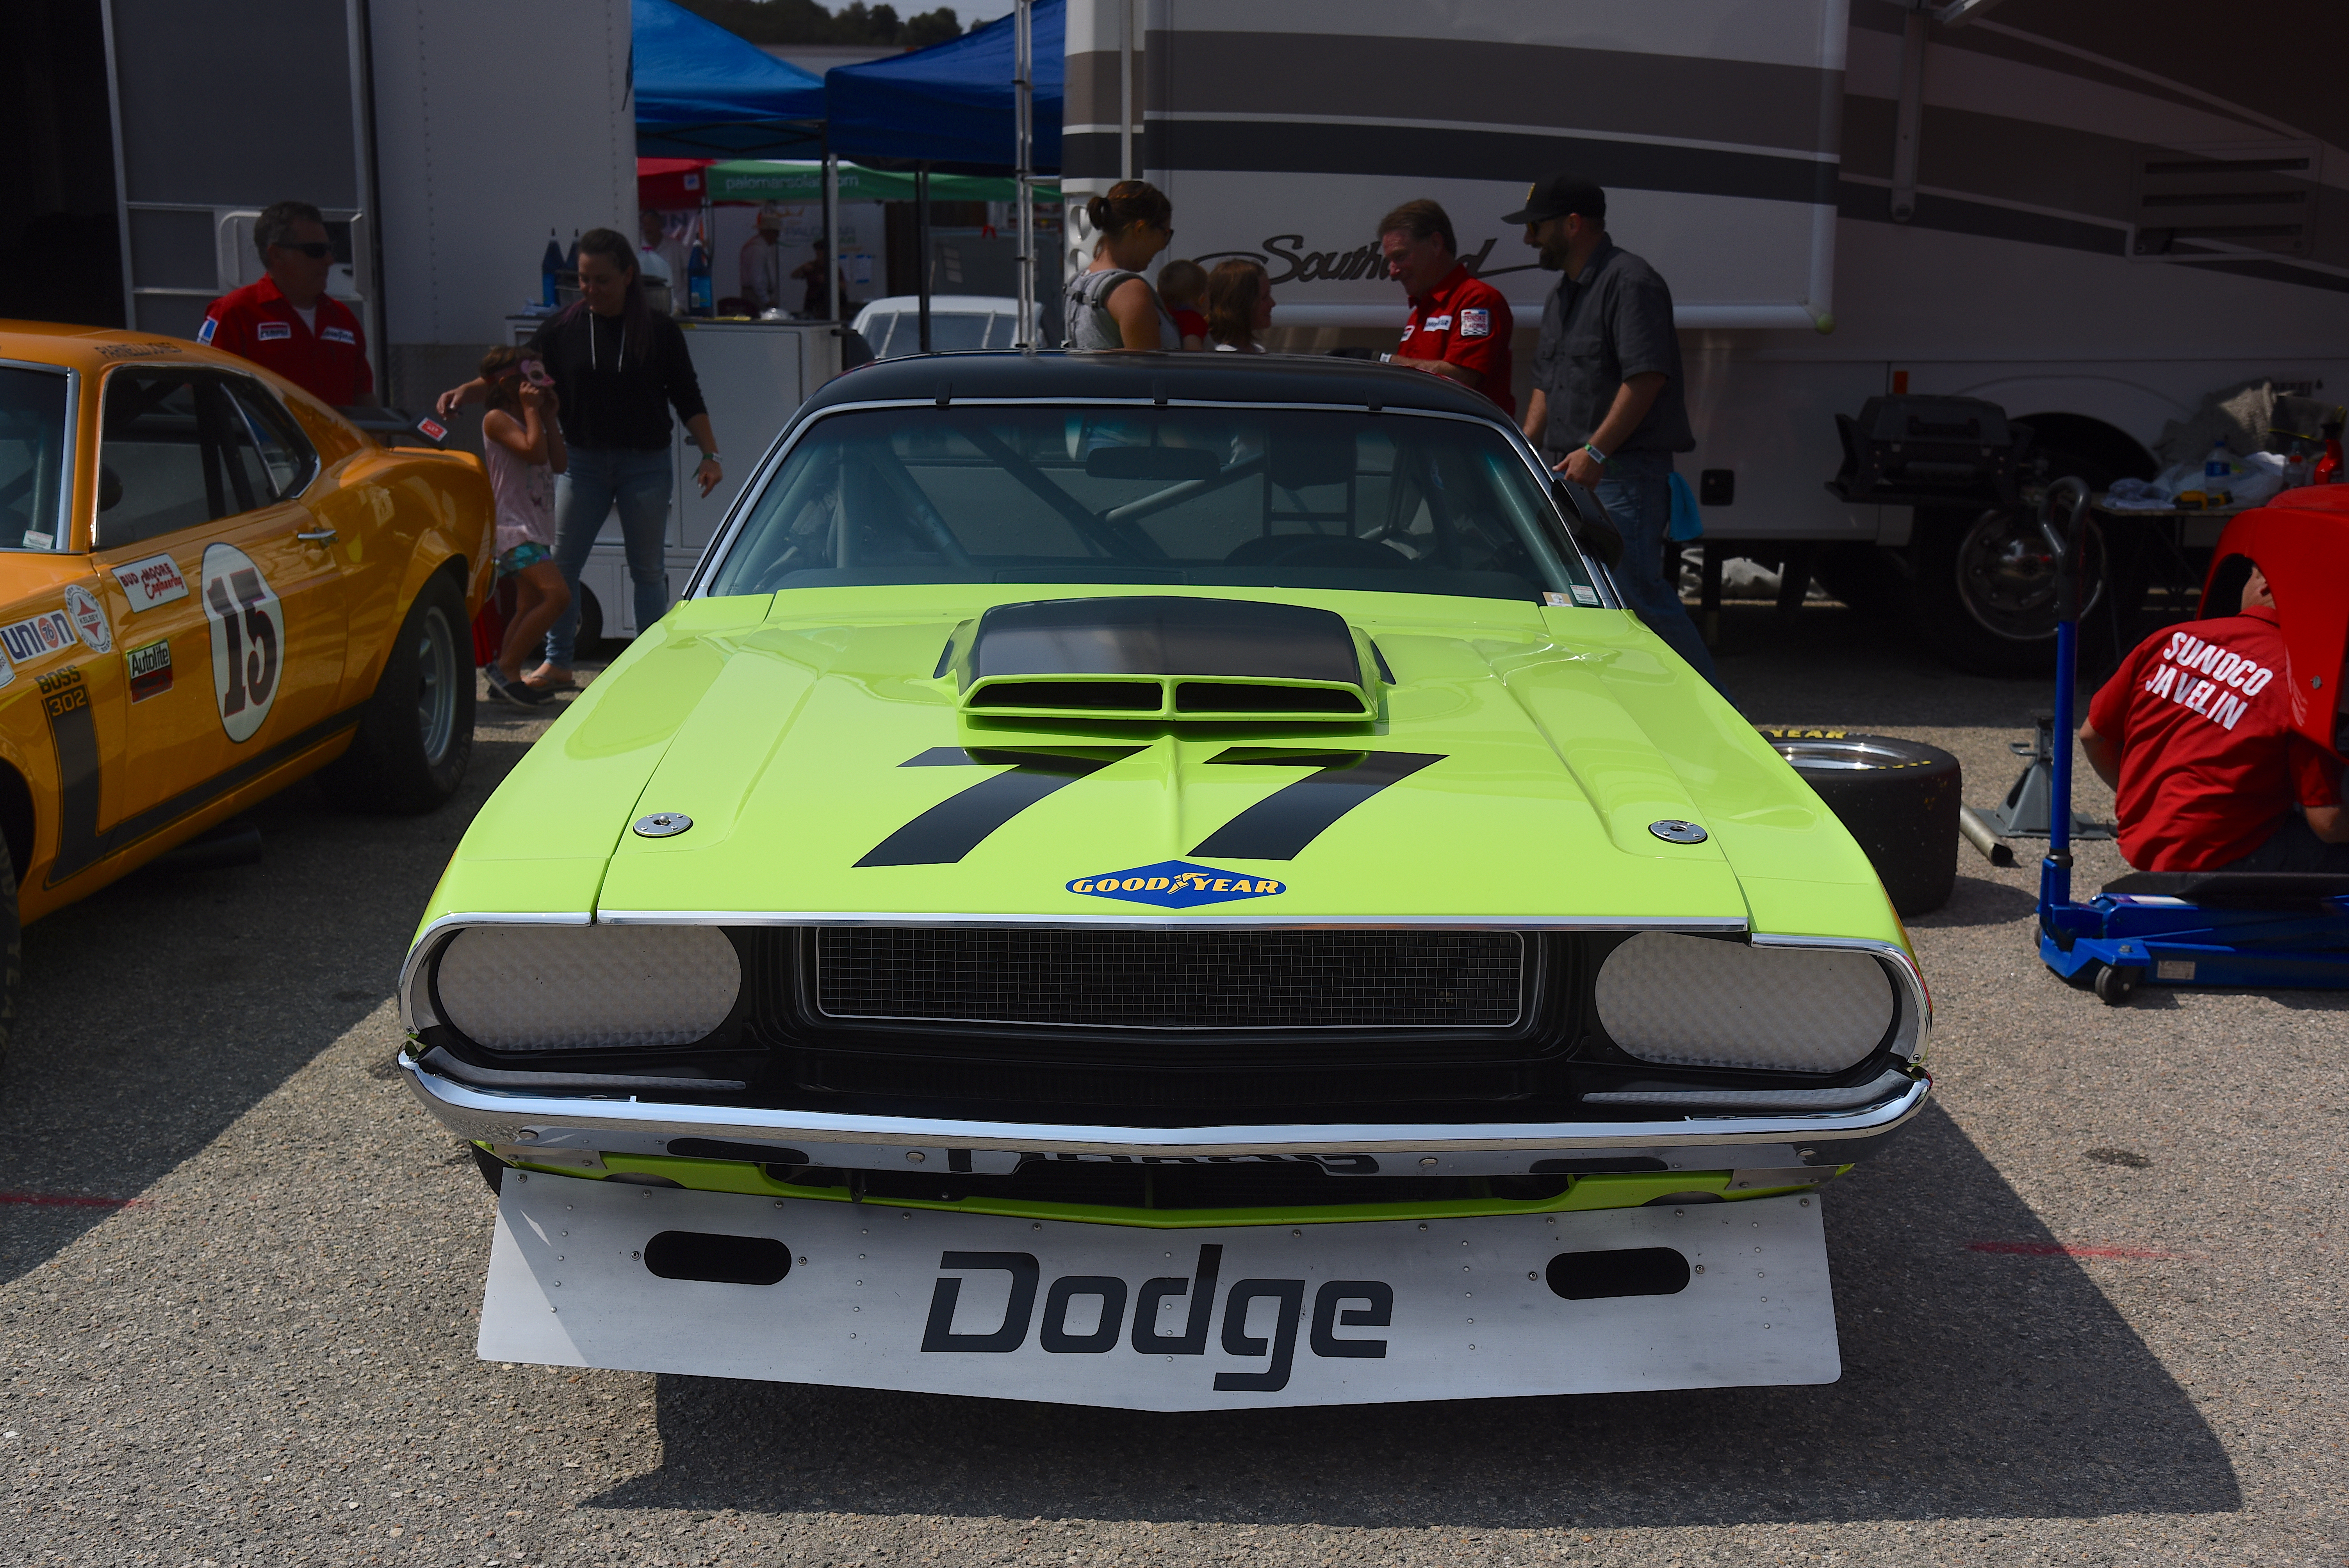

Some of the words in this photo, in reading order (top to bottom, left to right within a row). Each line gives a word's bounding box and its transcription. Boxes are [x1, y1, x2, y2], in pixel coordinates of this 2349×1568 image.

[726, 173, 859, 193] palomarsolarom
[119, 573, 139, 587] BUD
[142, 563, 172, 581] MOORE
[42, 623, 55, 643] 76
[80, 614, 98, 624] KELSEY
[207, 567, 278, 718] 15
[132, 644, 168, 677] Autolite
[2163, 631, 2273, 697] SUNOCO
[34, 665, 81, 694] BOSS
[48, 688, 87, 716] 302
[2145, 664, 2248, 731] JAVELIN
[1768, 729, 1847, 739] YEAR
[921, 1244, 1394, 1392] Dodge
